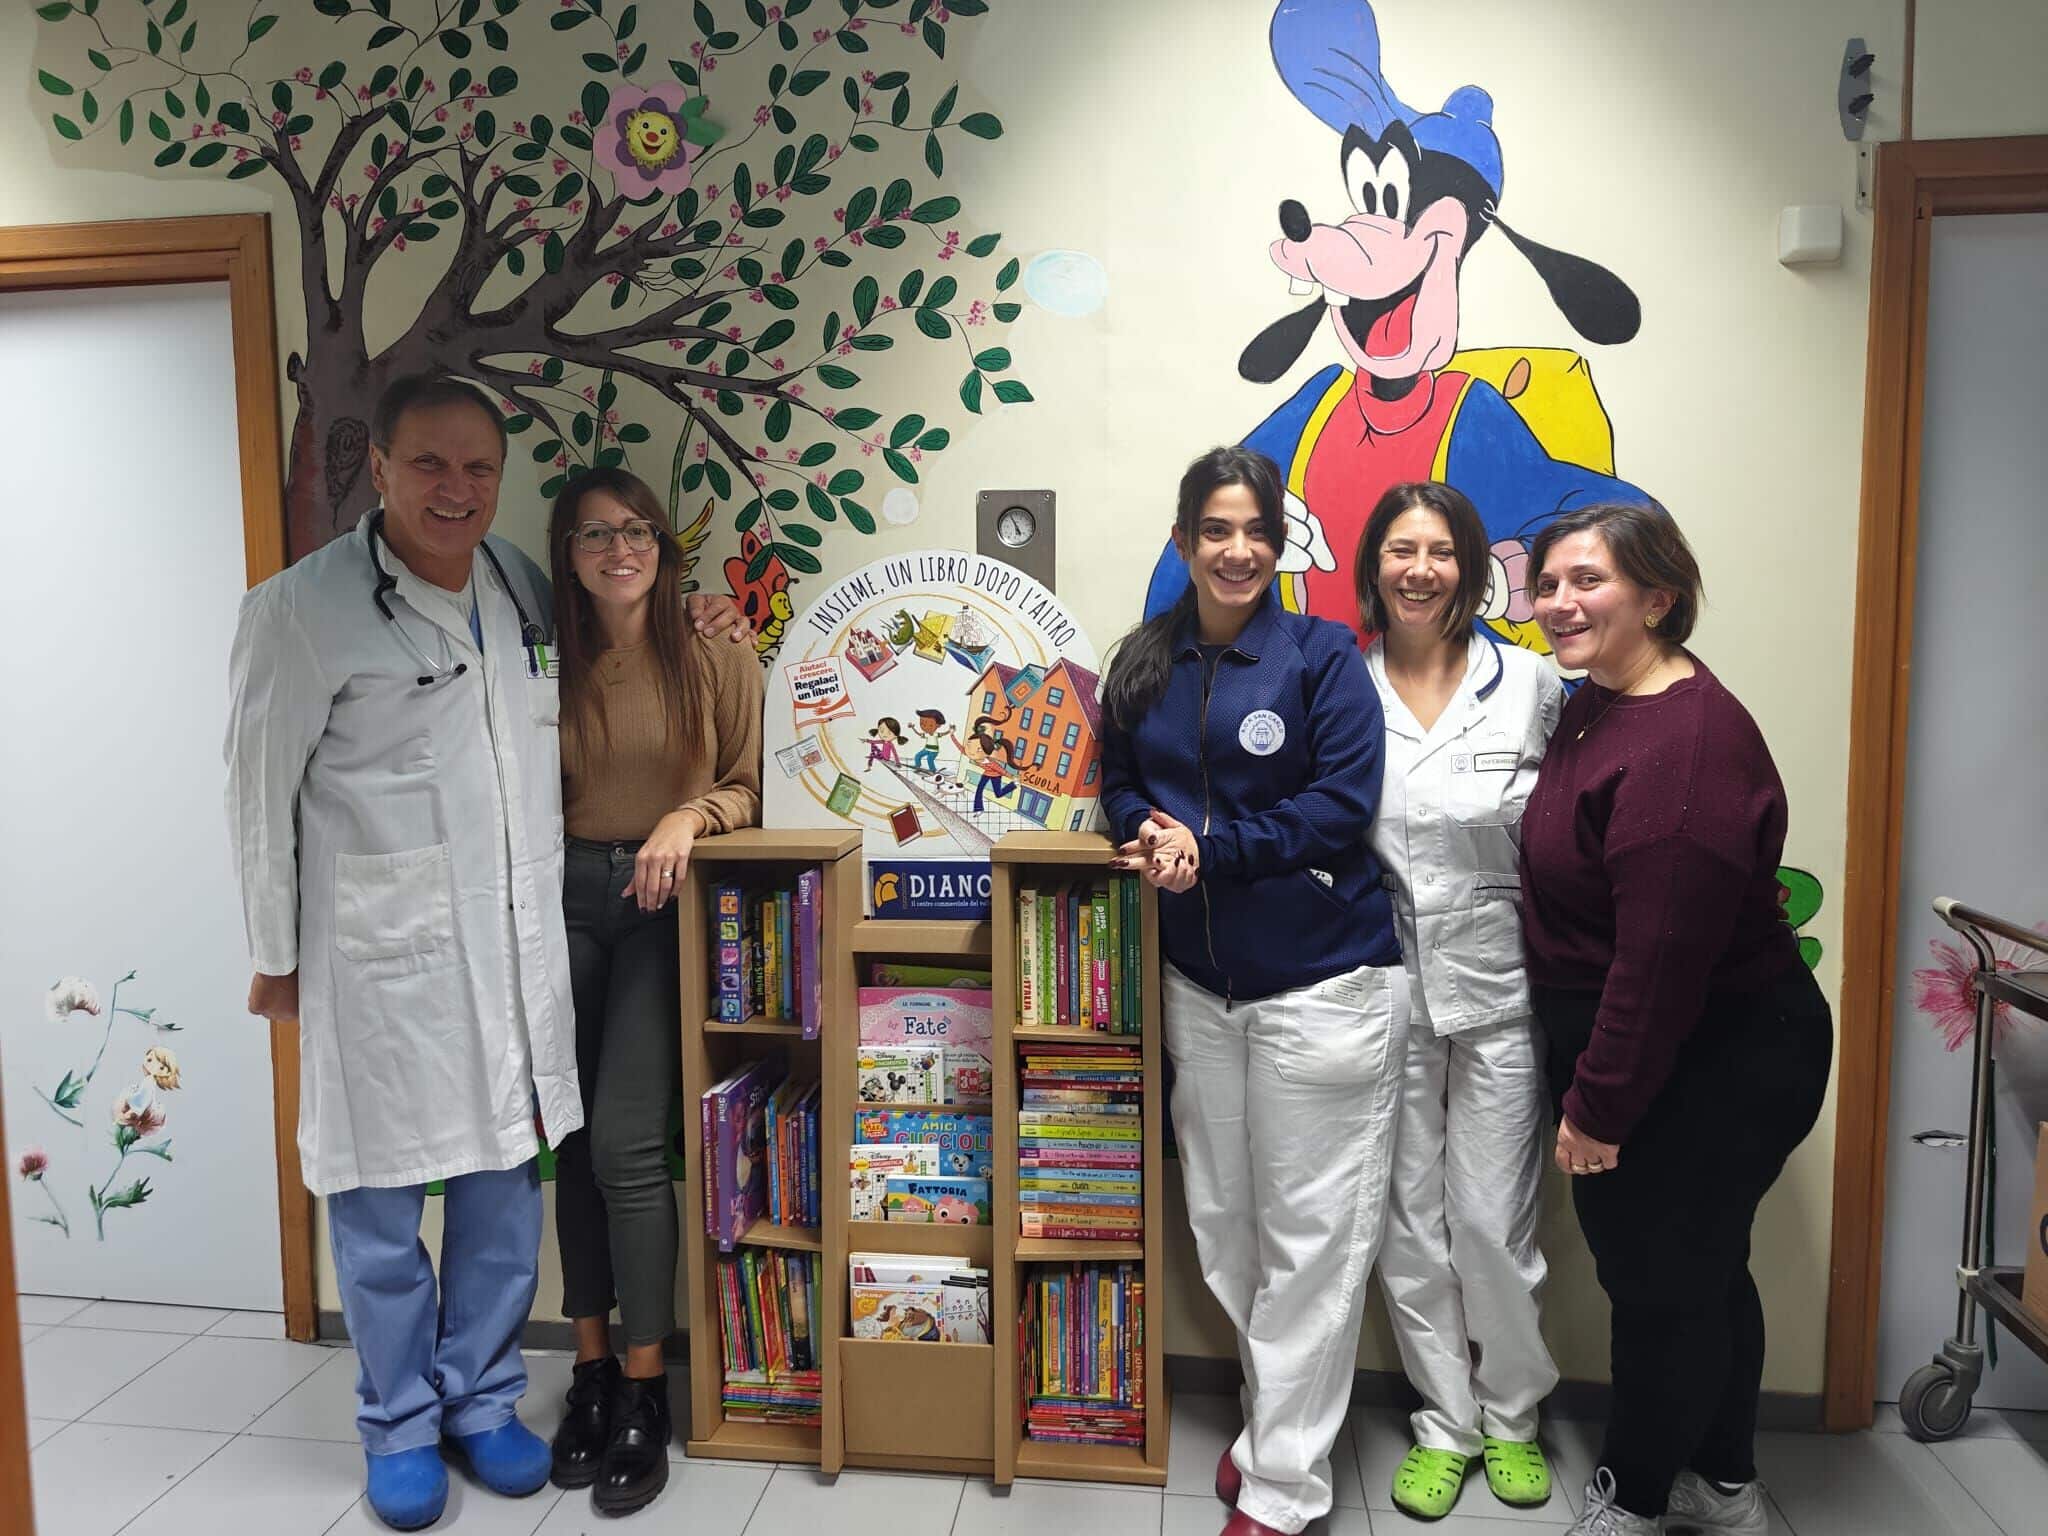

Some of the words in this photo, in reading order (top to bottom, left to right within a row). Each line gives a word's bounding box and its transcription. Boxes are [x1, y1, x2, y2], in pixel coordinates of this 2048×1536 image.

[807, 571, 885, 635] INSIEME,
[885, 559, 914, 589] UN
[919, 556, 968, 584] LIBRO
[974, 561, 1022, 602] DOPO
[1017, 585, 1079, 653] L'ALTRO.
[799, 661, 827, 673] Aiutaci
[794, 673, 839, 691] Regalaci
[797, 691, 812, 701] un
[811, 683, 840, 698] libro!
[1023, 771, 1061, 794] SCUOLA
[903, 1016, 947, 1035] Fate
[921, 1121, 957, 1132] AMICI
[894, 1131, 992, 1152] CUCCIOLI
[908, 1182, 967, 1197] FATTORIA
